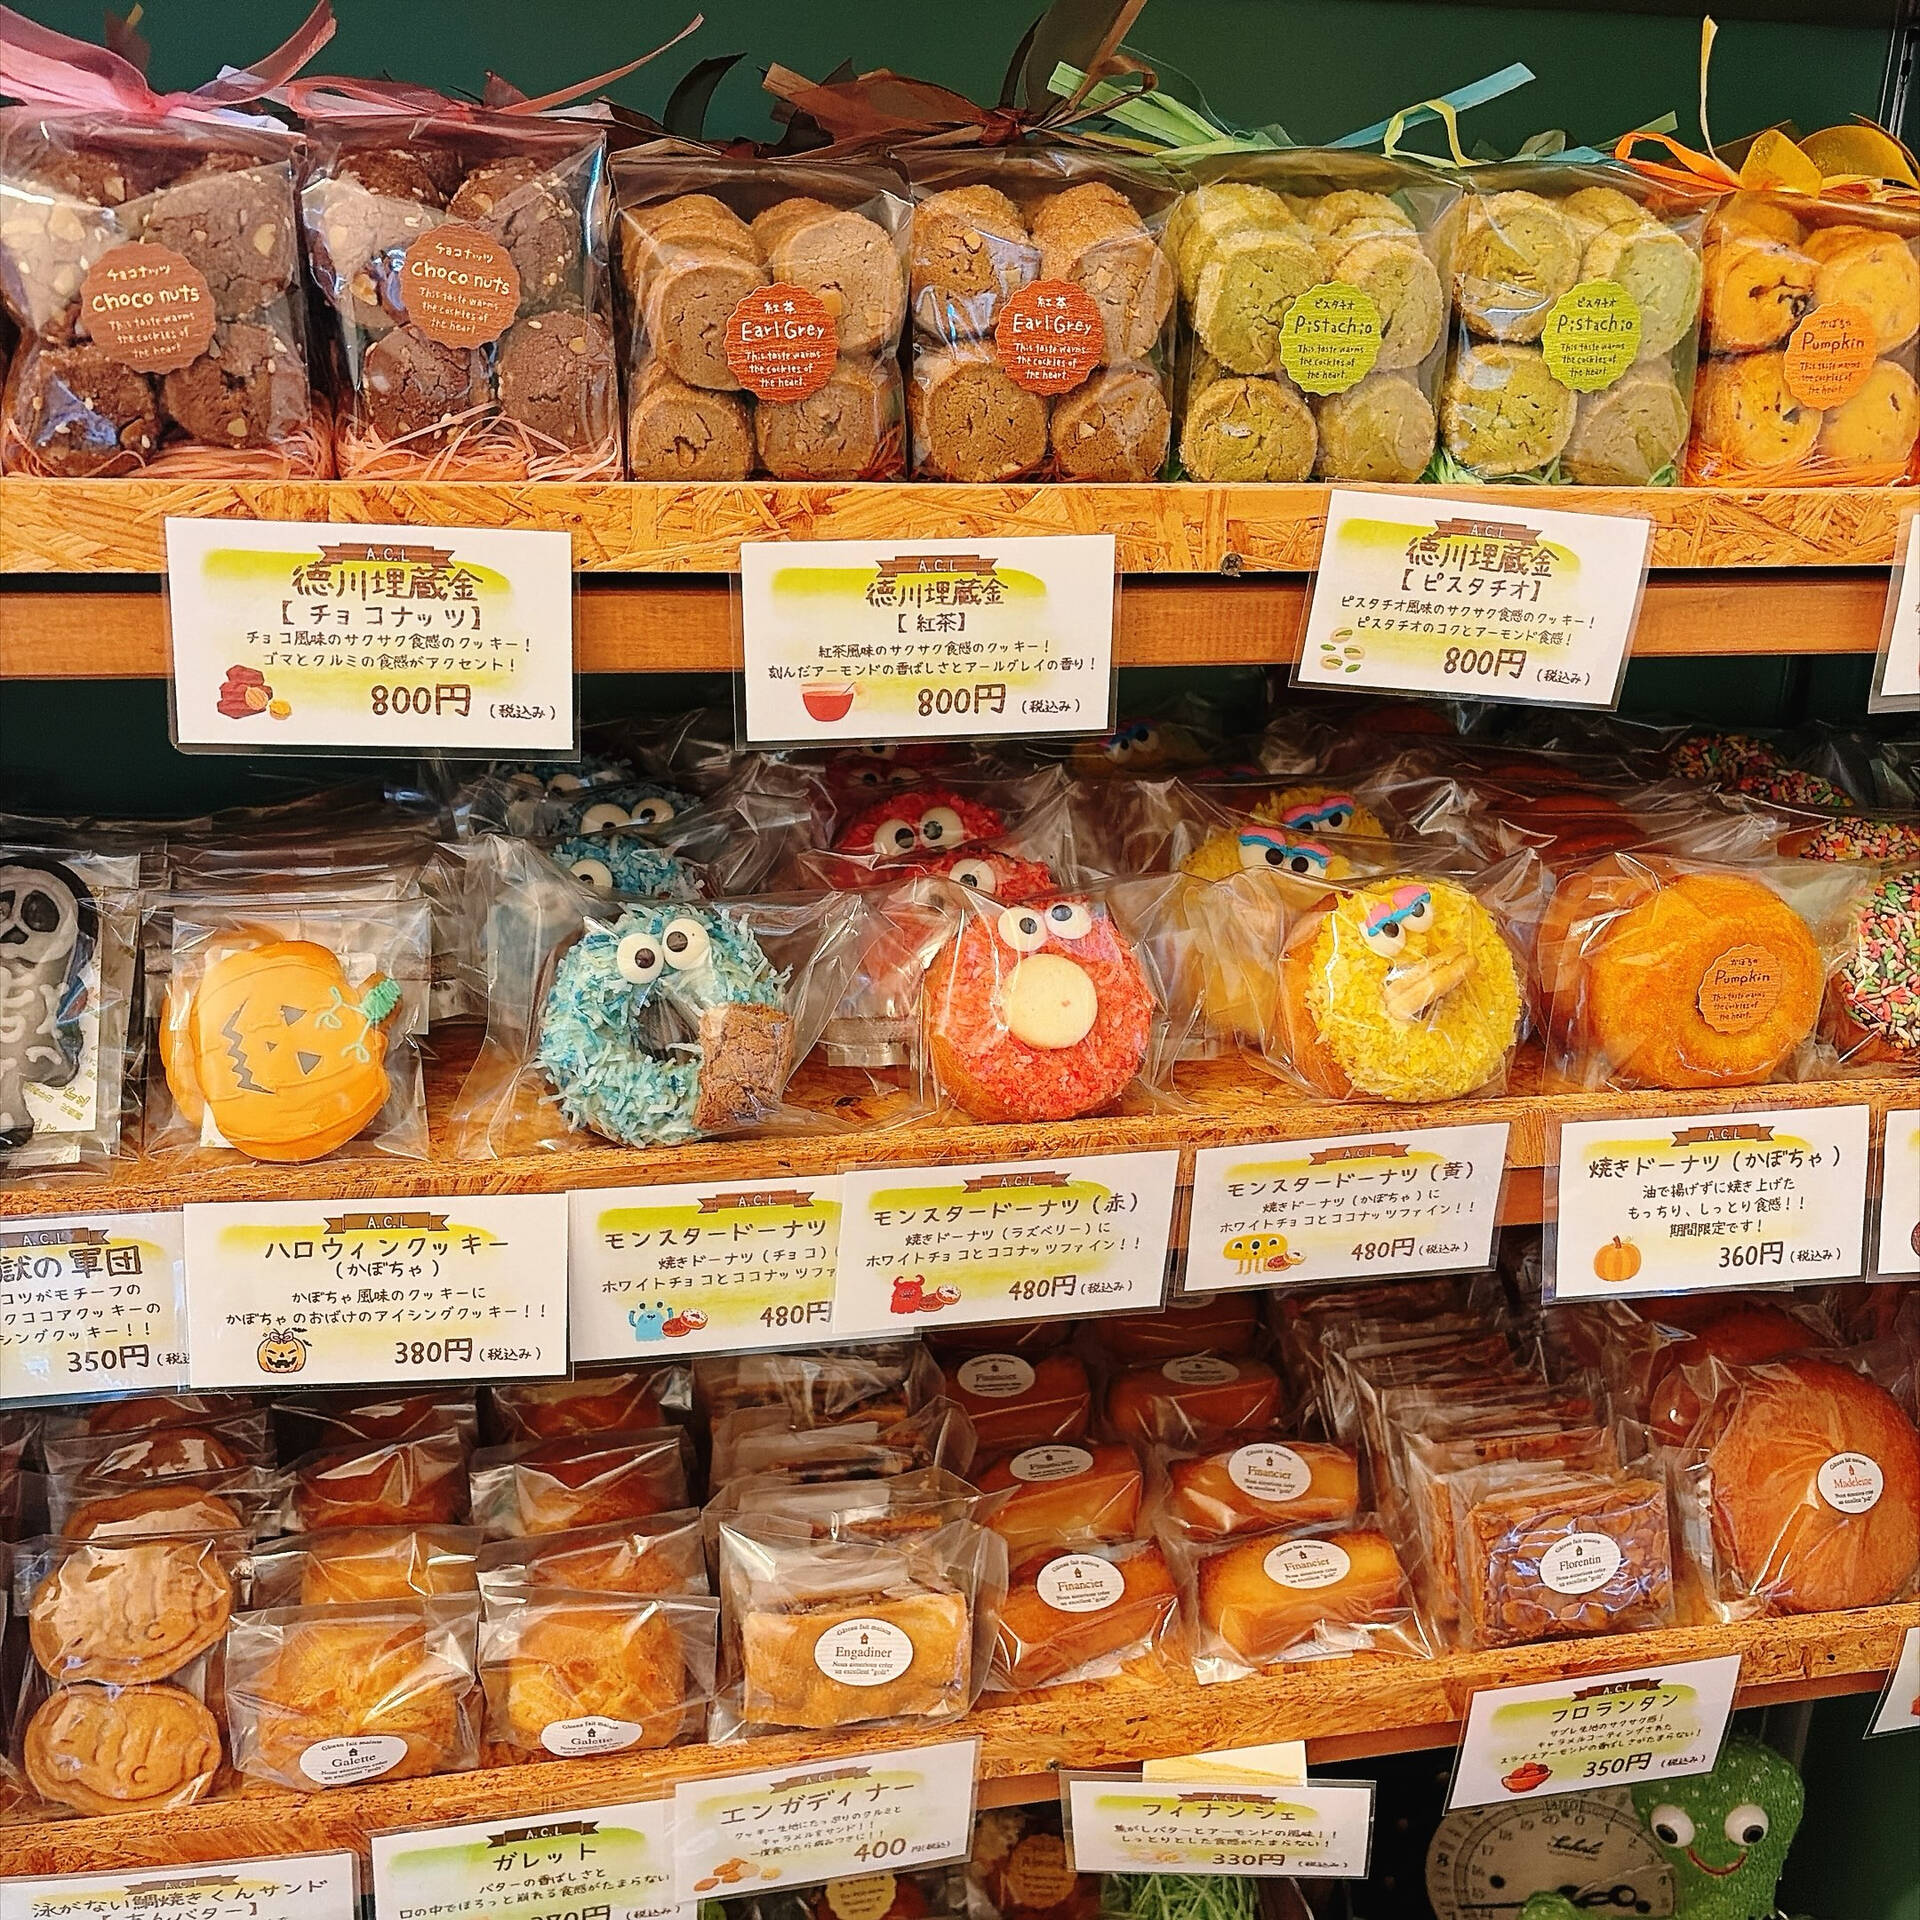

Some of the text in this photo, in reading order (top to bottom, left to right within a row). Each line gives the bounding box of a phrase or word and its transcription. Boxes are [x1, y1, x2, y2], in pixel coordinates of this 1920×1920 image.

[411, 261, 510, 295] Choco nuts
[92, 284, 200, 312] Choco nuts
[1295, 315, 1372, 334] Pistachio
[1557, 314, 1633, 333] Pistachio
[1014, 343, 1032, 352] This
[1802, 332, 1864, 353] Pumpkin
[746, 351, 766, 362] This
[1405, 536, 1559, 578] 徳川埋蔵金
[292, 565, 483, 601] 徳川埋蔵金
[865, 578, 1009, 608] 徳川埋蔵金
[1401, 568, 1542, 602] 【ピスタチオ】
[282, 600, 482, 631] 【チョコナッツ】
[897, 613, 967, 633] 【紅茶】
[1341, 596, 1596, 629] ピスタチオ風味のサクサク食感のクッキー！
[247, 631, 532, 652] チョコ風味のサクサク食感のクッキー！
[1357, 617, 1572, 646] ピスタチオのコクとアーモンド食感！
[263, 651, 516, 672] ゴマとクルミの食感がアクセント！
[818, 639, 1050, 658] 紅茶風味のサクサク食感のクッキー！
[768, 658, 1096, 679] 刻んだアーモンドの香ばしさとアールグレイの香り！
[1443, 646, 1591, 686] 800円 （税込み）
[371, 683, 556, 721] 800円 （税込み）
[918, 683, 1081, 718] 800円 （税込み）
[1715, 969, 1770, 986] Pumpkin
[1589, 1145, 1841, 1180] 焼きドーナツ（かぼちゃ）
[1228, 1160, 1475, 1197] モンスタードーナツ（黄）
[1643, 1177, 1796, 1200] 油で揚げずに焼き上げた
[874, 1192, 1139, 1226] モンスタードーナツ（赤）
[1262, 1189, 1440, 1213] 焼きドーナツ（かぼちゃ）に
[1628, 1196, 1805, 1220] もっちり、しっとり食感！！
[1220, 1201, 1475, 1234] ホワイトチョコとココナッツファイン！！
[1669, 1220, 1763, 1238] 期間限定です！
[605, 1220, 827, 1250] モンスタードーナツ
[905, 1221, 1110, 1246] 焼きドーナツ（ラズベリー）に
[265, 1234, 509, 1260] ハロウィンクッキー
[658, 1246, 838, 1270] 焼きドーナツ（チョコ）
[866, 1237, 1140, 1268] ホワイトチョコとココナッツファイン！！
[1351, 1237, 1415, 1261] 480円
[1718, 1241, 1841, 1268] 360円 （税込み）
[336, 1259, 439, 1279] （かぼちゃ）
[292, 1287, 486, 1303] かぼちゃ風味のクッキーに
[1009, 1274, 1133, 1302] 480円 （税込み）
[4, 1302, 161, 1325] クココアクッキーの
[226, 1304, 546, 1326] かぼちゃのおばけのアイシングクッキー！！
[760, 1301, 831, 1327] 480円
[67, 1344, 149, 1372] 350円
[395, 1337, 541, 1364] 380円 （税込み）
[1560, 1555, 1600, 1571] Florentin
[836, 1646, 892, 1660] Engadiner
[1552, 1694, 1678, 1723] フロランタン
[332, 1754, 376, 1767] Galette
[1584, 1752, 1652, 1778] 350円
[721, 1783, 914, 1825] エンガディナー
[1143, 1803, 1296, 1821] フィナンシェ
[493, 1843, 596, 1872] ガレット
[854, 1838, 906, 1861] 400
[1213, 1853, 1285, 1866] 330円
[480, 1867, 606, 1894] バターの香ばしさと
[32, 1879, 327, 1919] 泳がない鯛焼きくんサンド
[400, 1873, 670, 1919] 口の中でほろっと崩れる食感がたまらない
